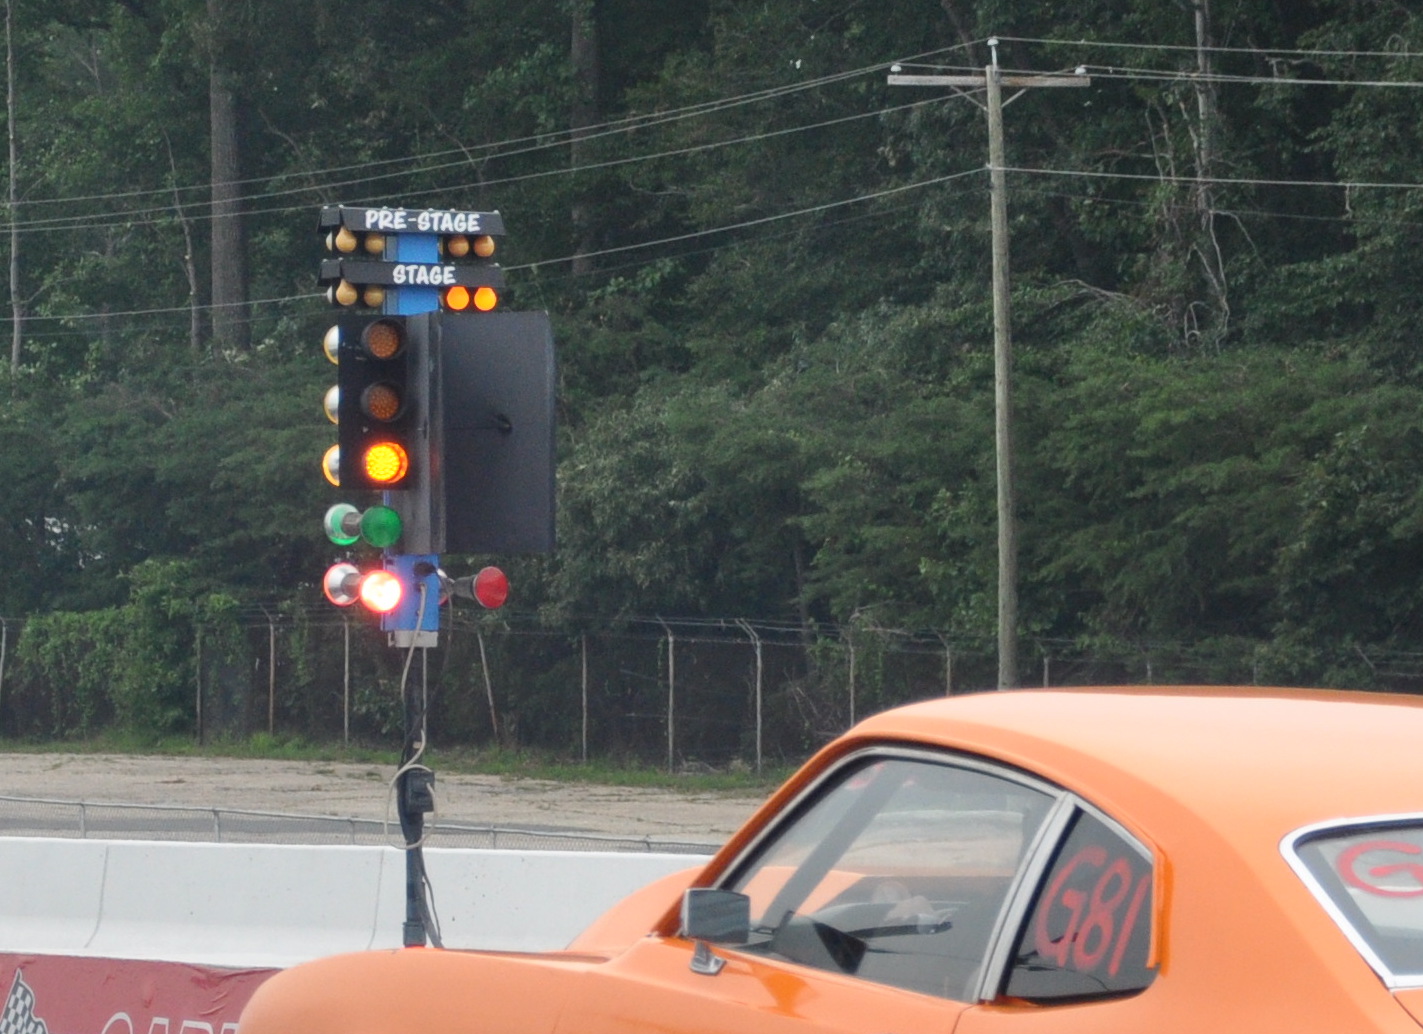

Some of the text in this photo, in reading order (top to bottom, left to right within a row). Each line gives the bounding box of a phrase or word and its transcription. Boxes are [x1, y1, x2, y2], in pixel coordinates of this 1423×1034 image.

[364, 209, 481, 233] PRE-STAGE
[392, 264, 457, 285] STAGE
[1035, 845, 1151, 978] G81
